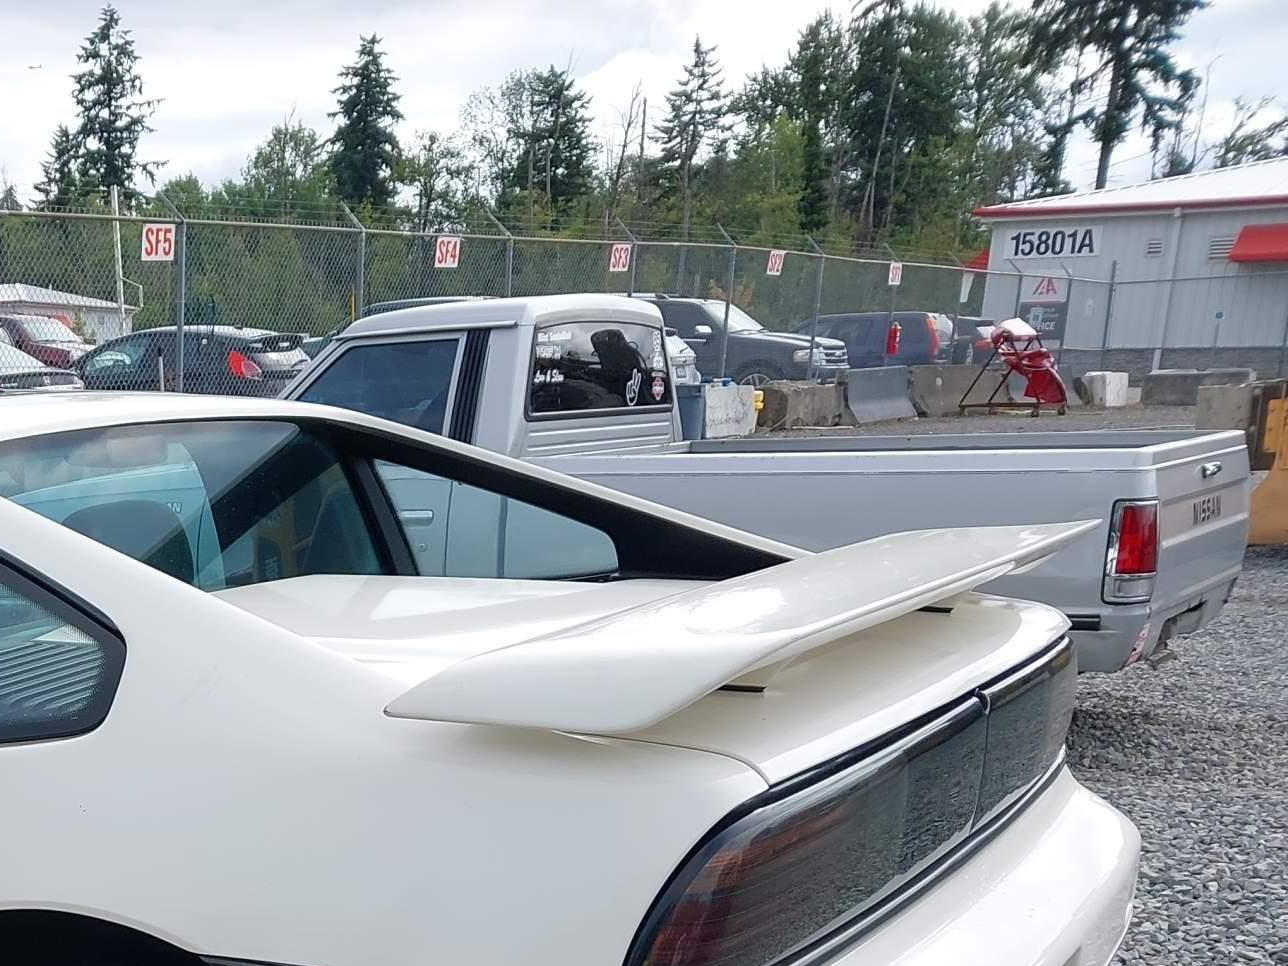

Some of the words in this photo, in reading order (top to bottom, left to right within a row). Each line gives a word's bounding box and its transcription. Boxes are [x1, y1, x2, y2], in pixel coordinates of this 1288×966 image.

[145, 227, 172, 256] SF5
[437, 240, 458, 264] SF4
[1011, 229, 1095, 257] 15801A
[612, 247, 630, 269] SF3
[769, 253, 783, 273] SF2
[1192, 496, 1222, 526] NISSAN
